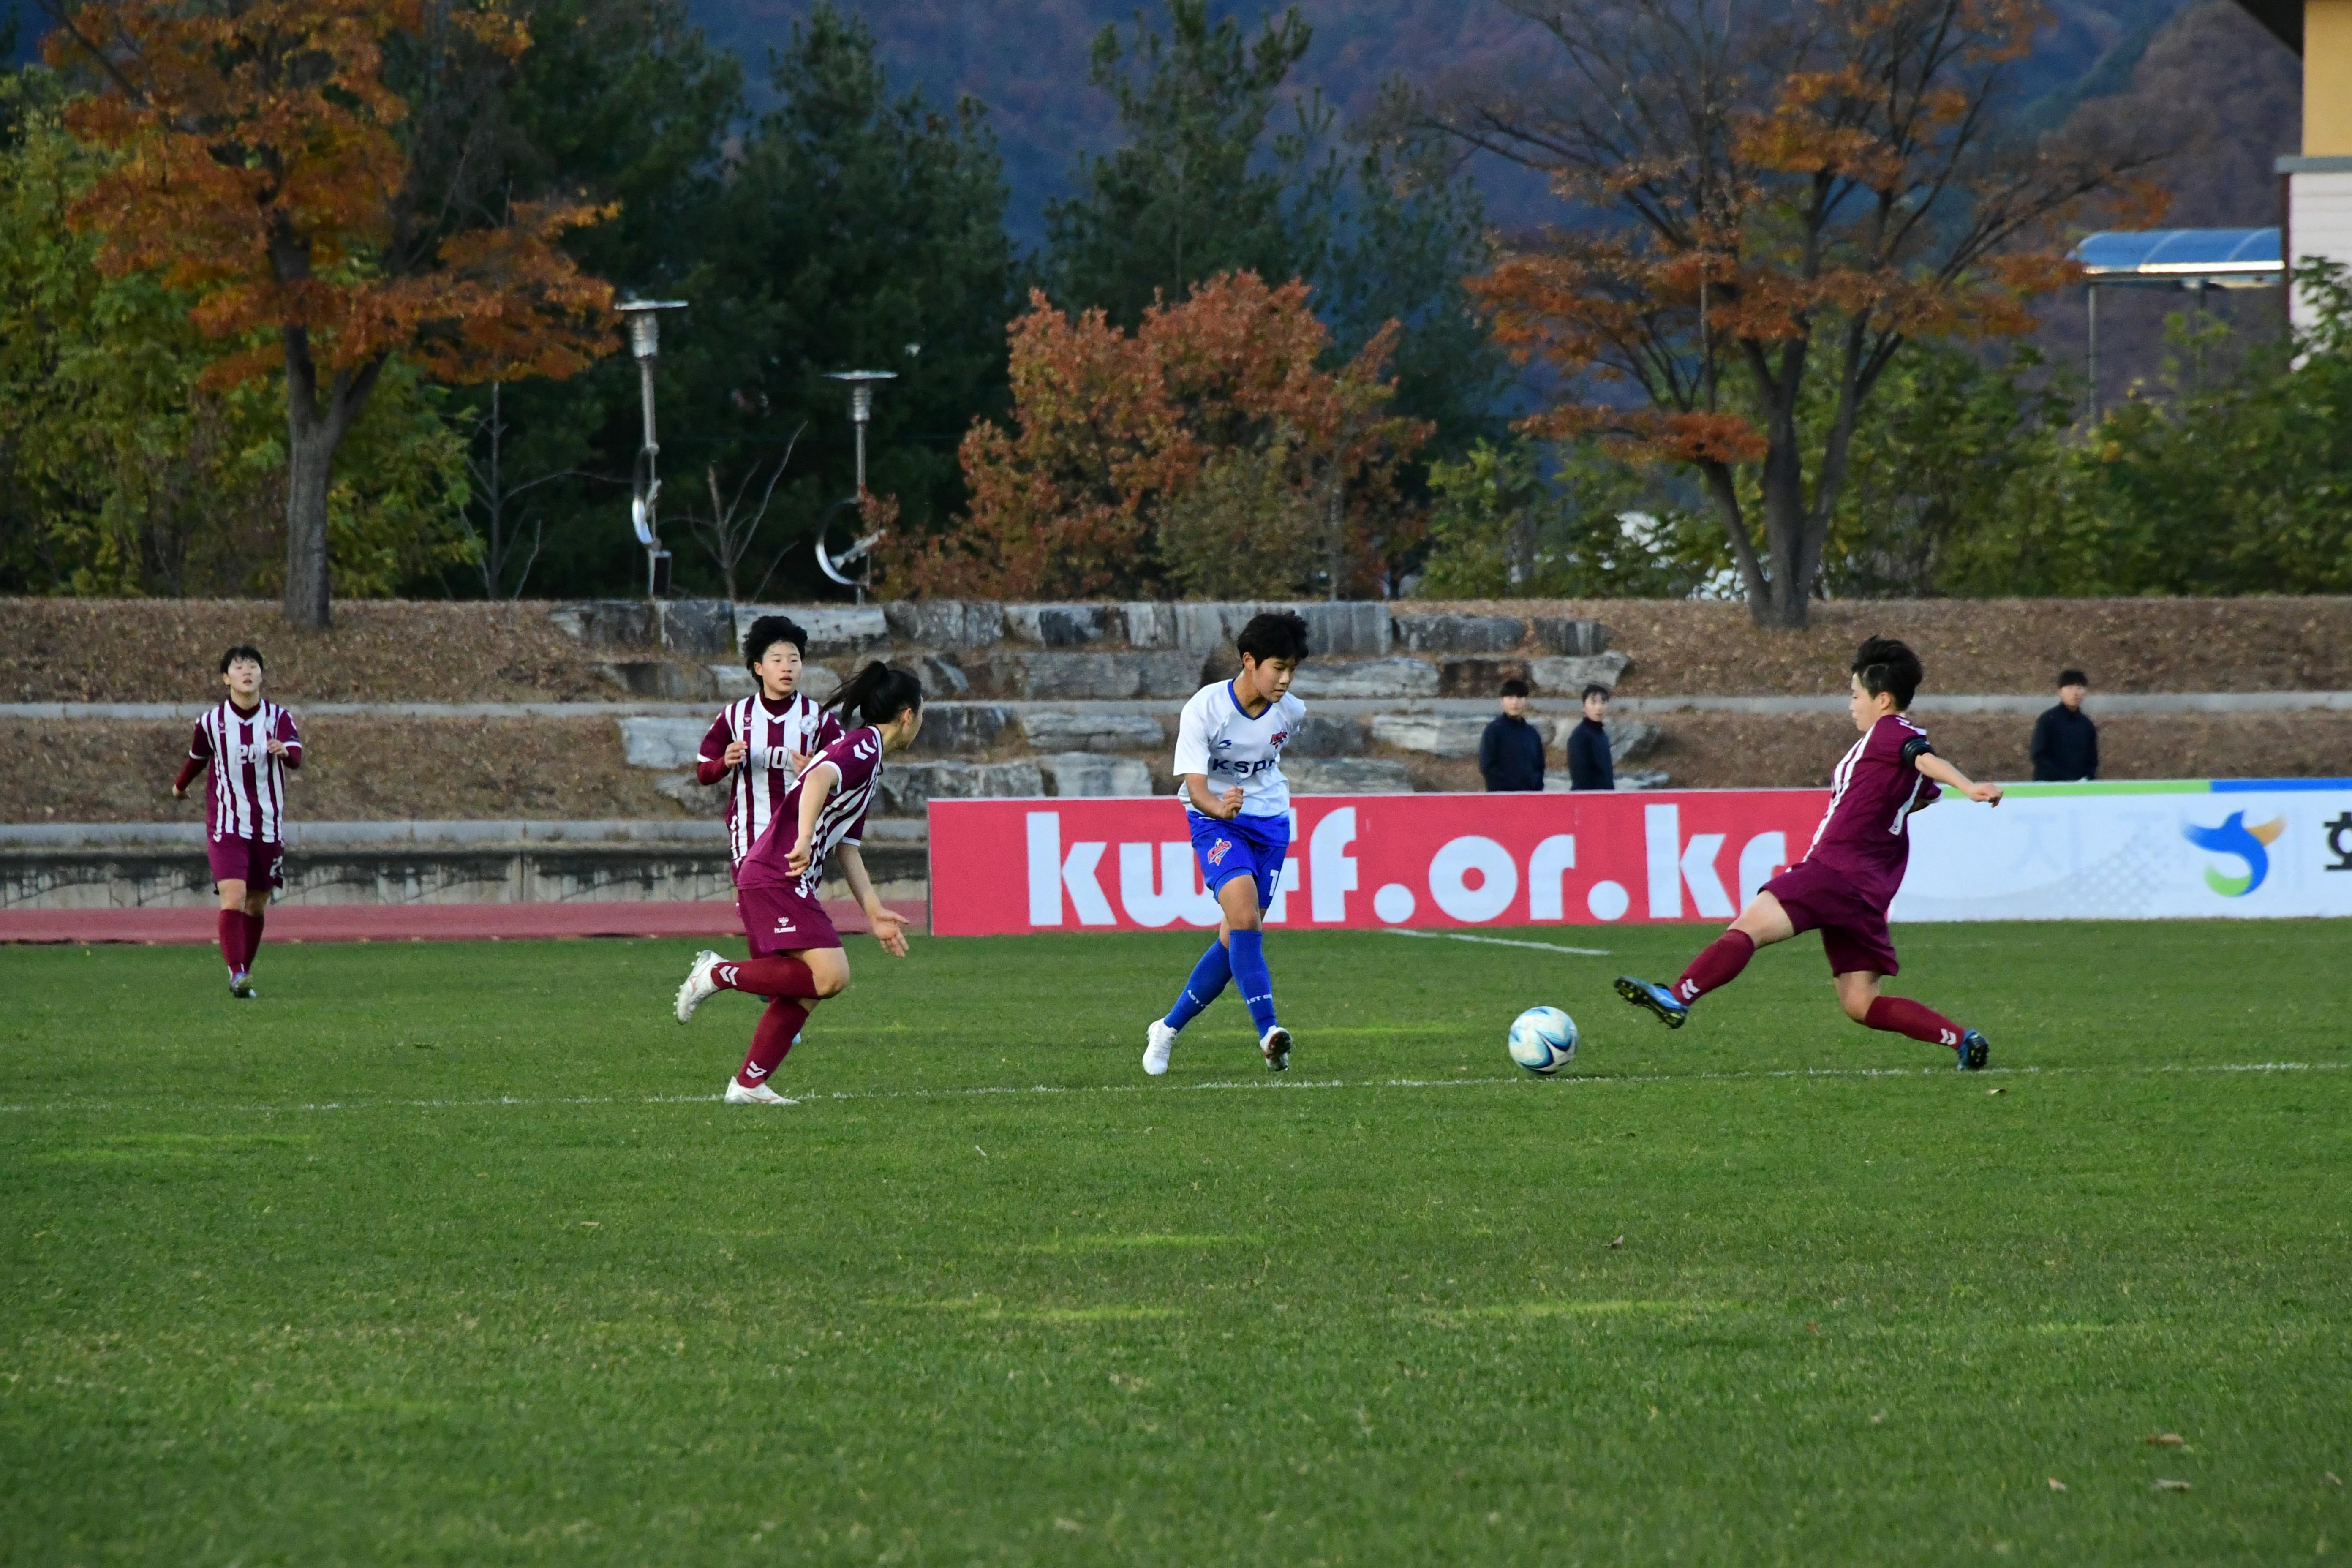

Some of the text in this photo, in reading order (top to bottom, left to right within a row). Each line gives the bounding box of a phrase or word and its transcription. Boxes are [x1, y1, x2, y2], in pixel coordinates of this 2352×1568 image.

[235, 744, 261, 765] 20
[763, 746, 789, 769] 10
[270, 855, 283, 877] 2
